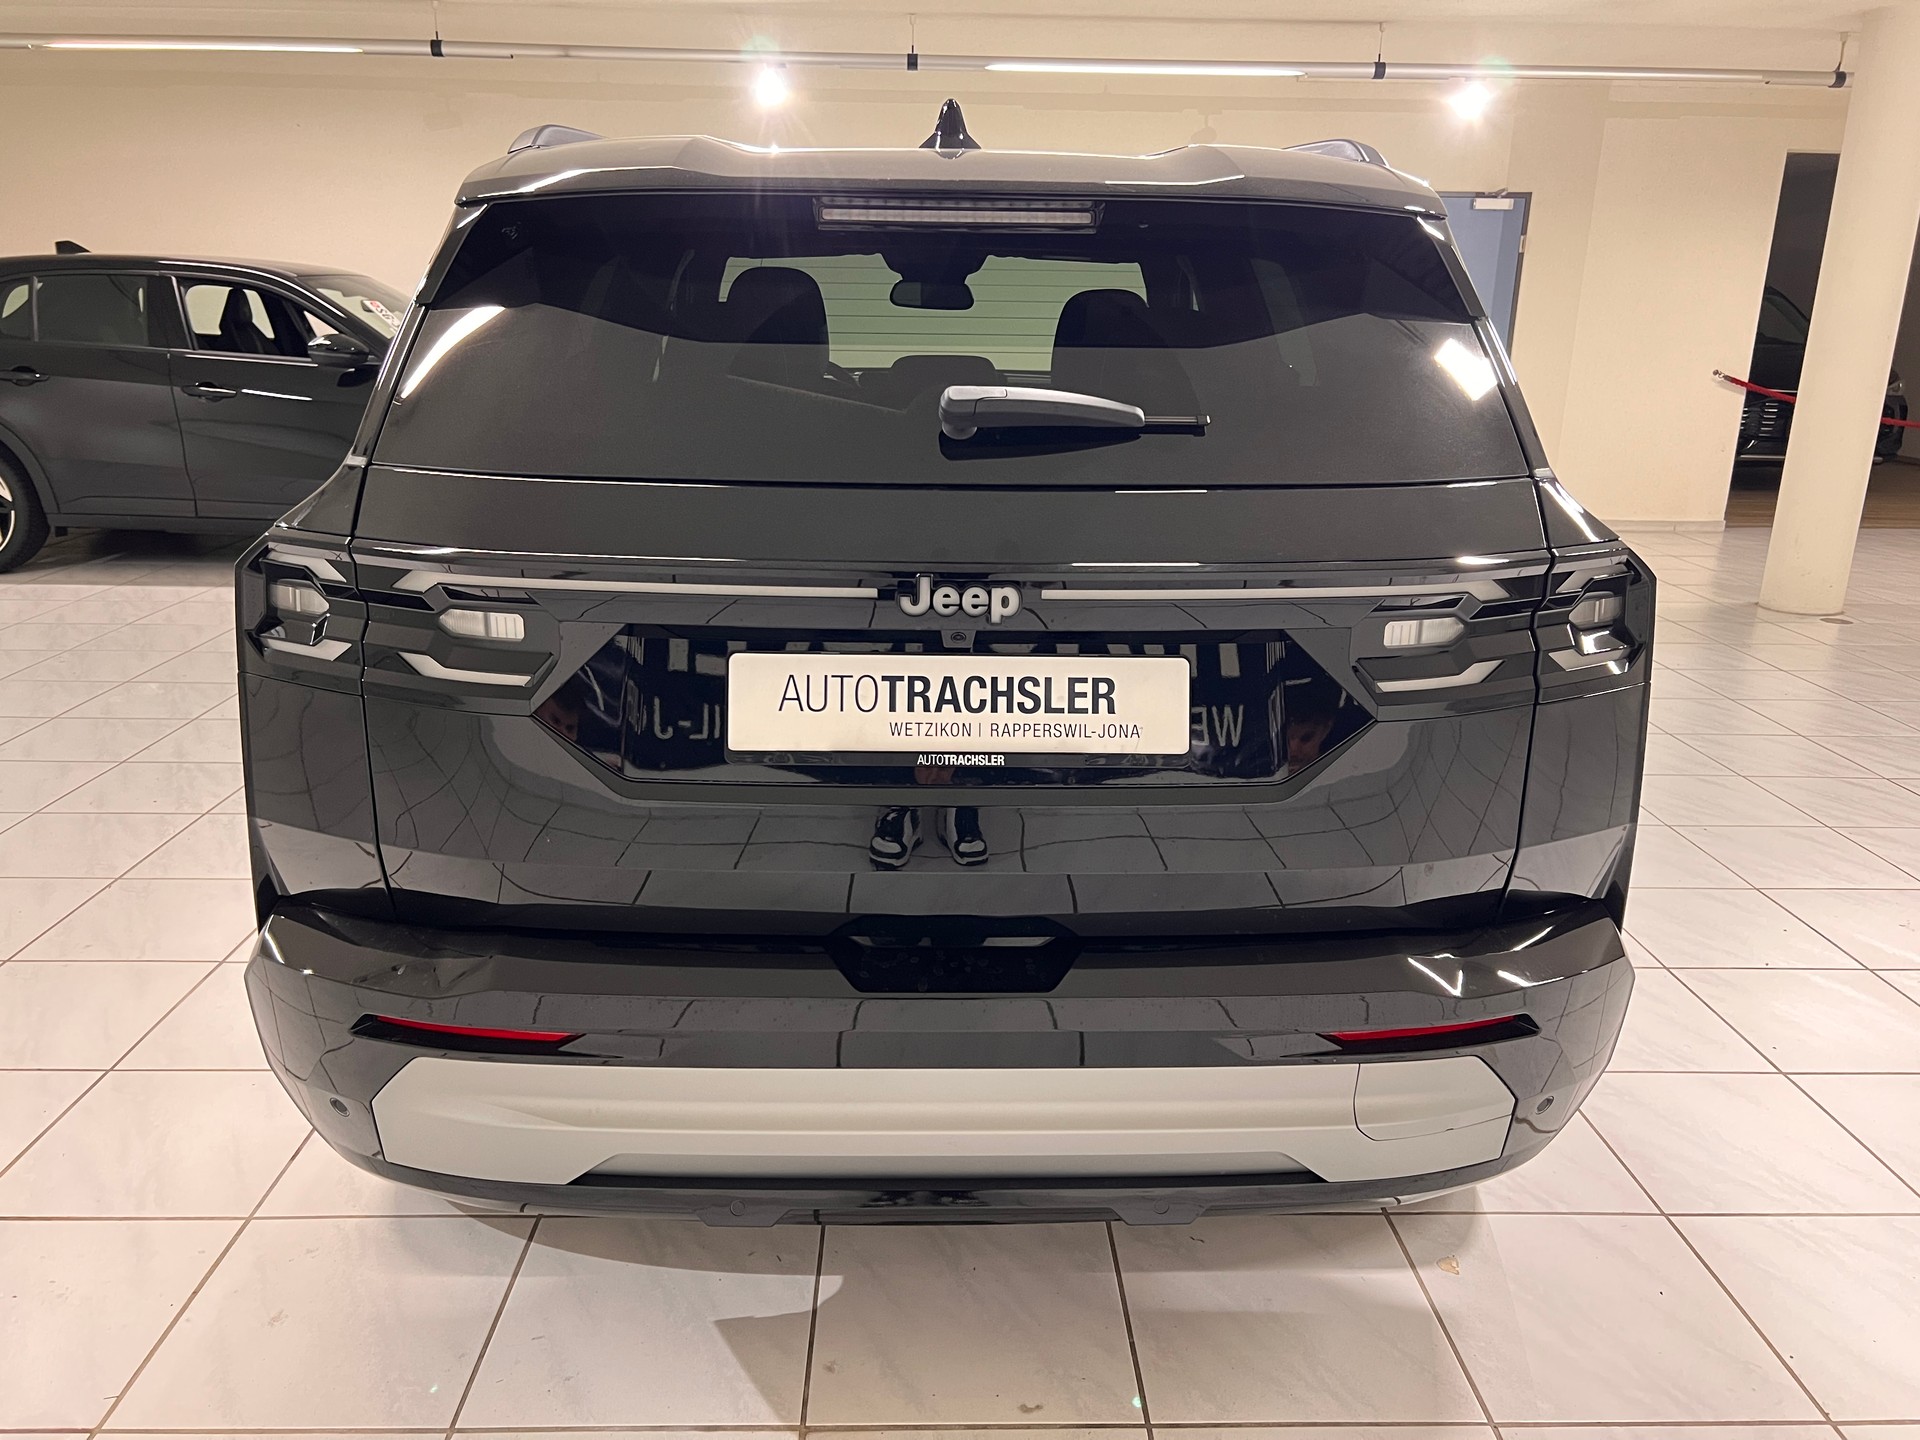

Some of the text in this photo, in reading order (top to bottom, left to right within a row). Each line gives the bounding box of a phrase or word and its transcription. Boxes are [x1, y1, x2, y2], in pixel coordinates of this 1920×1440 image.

[899, 573, 1021, 623] Jeep
[778, 674, 1117, 715] AUTOTRACHSLER
[889, 721, 972, 738] WETZIKON
[990, 722, 1141, 739] RAPPERSWIL-JONA
[916, 754, 1005, 766] AUTOTRACHSLER
